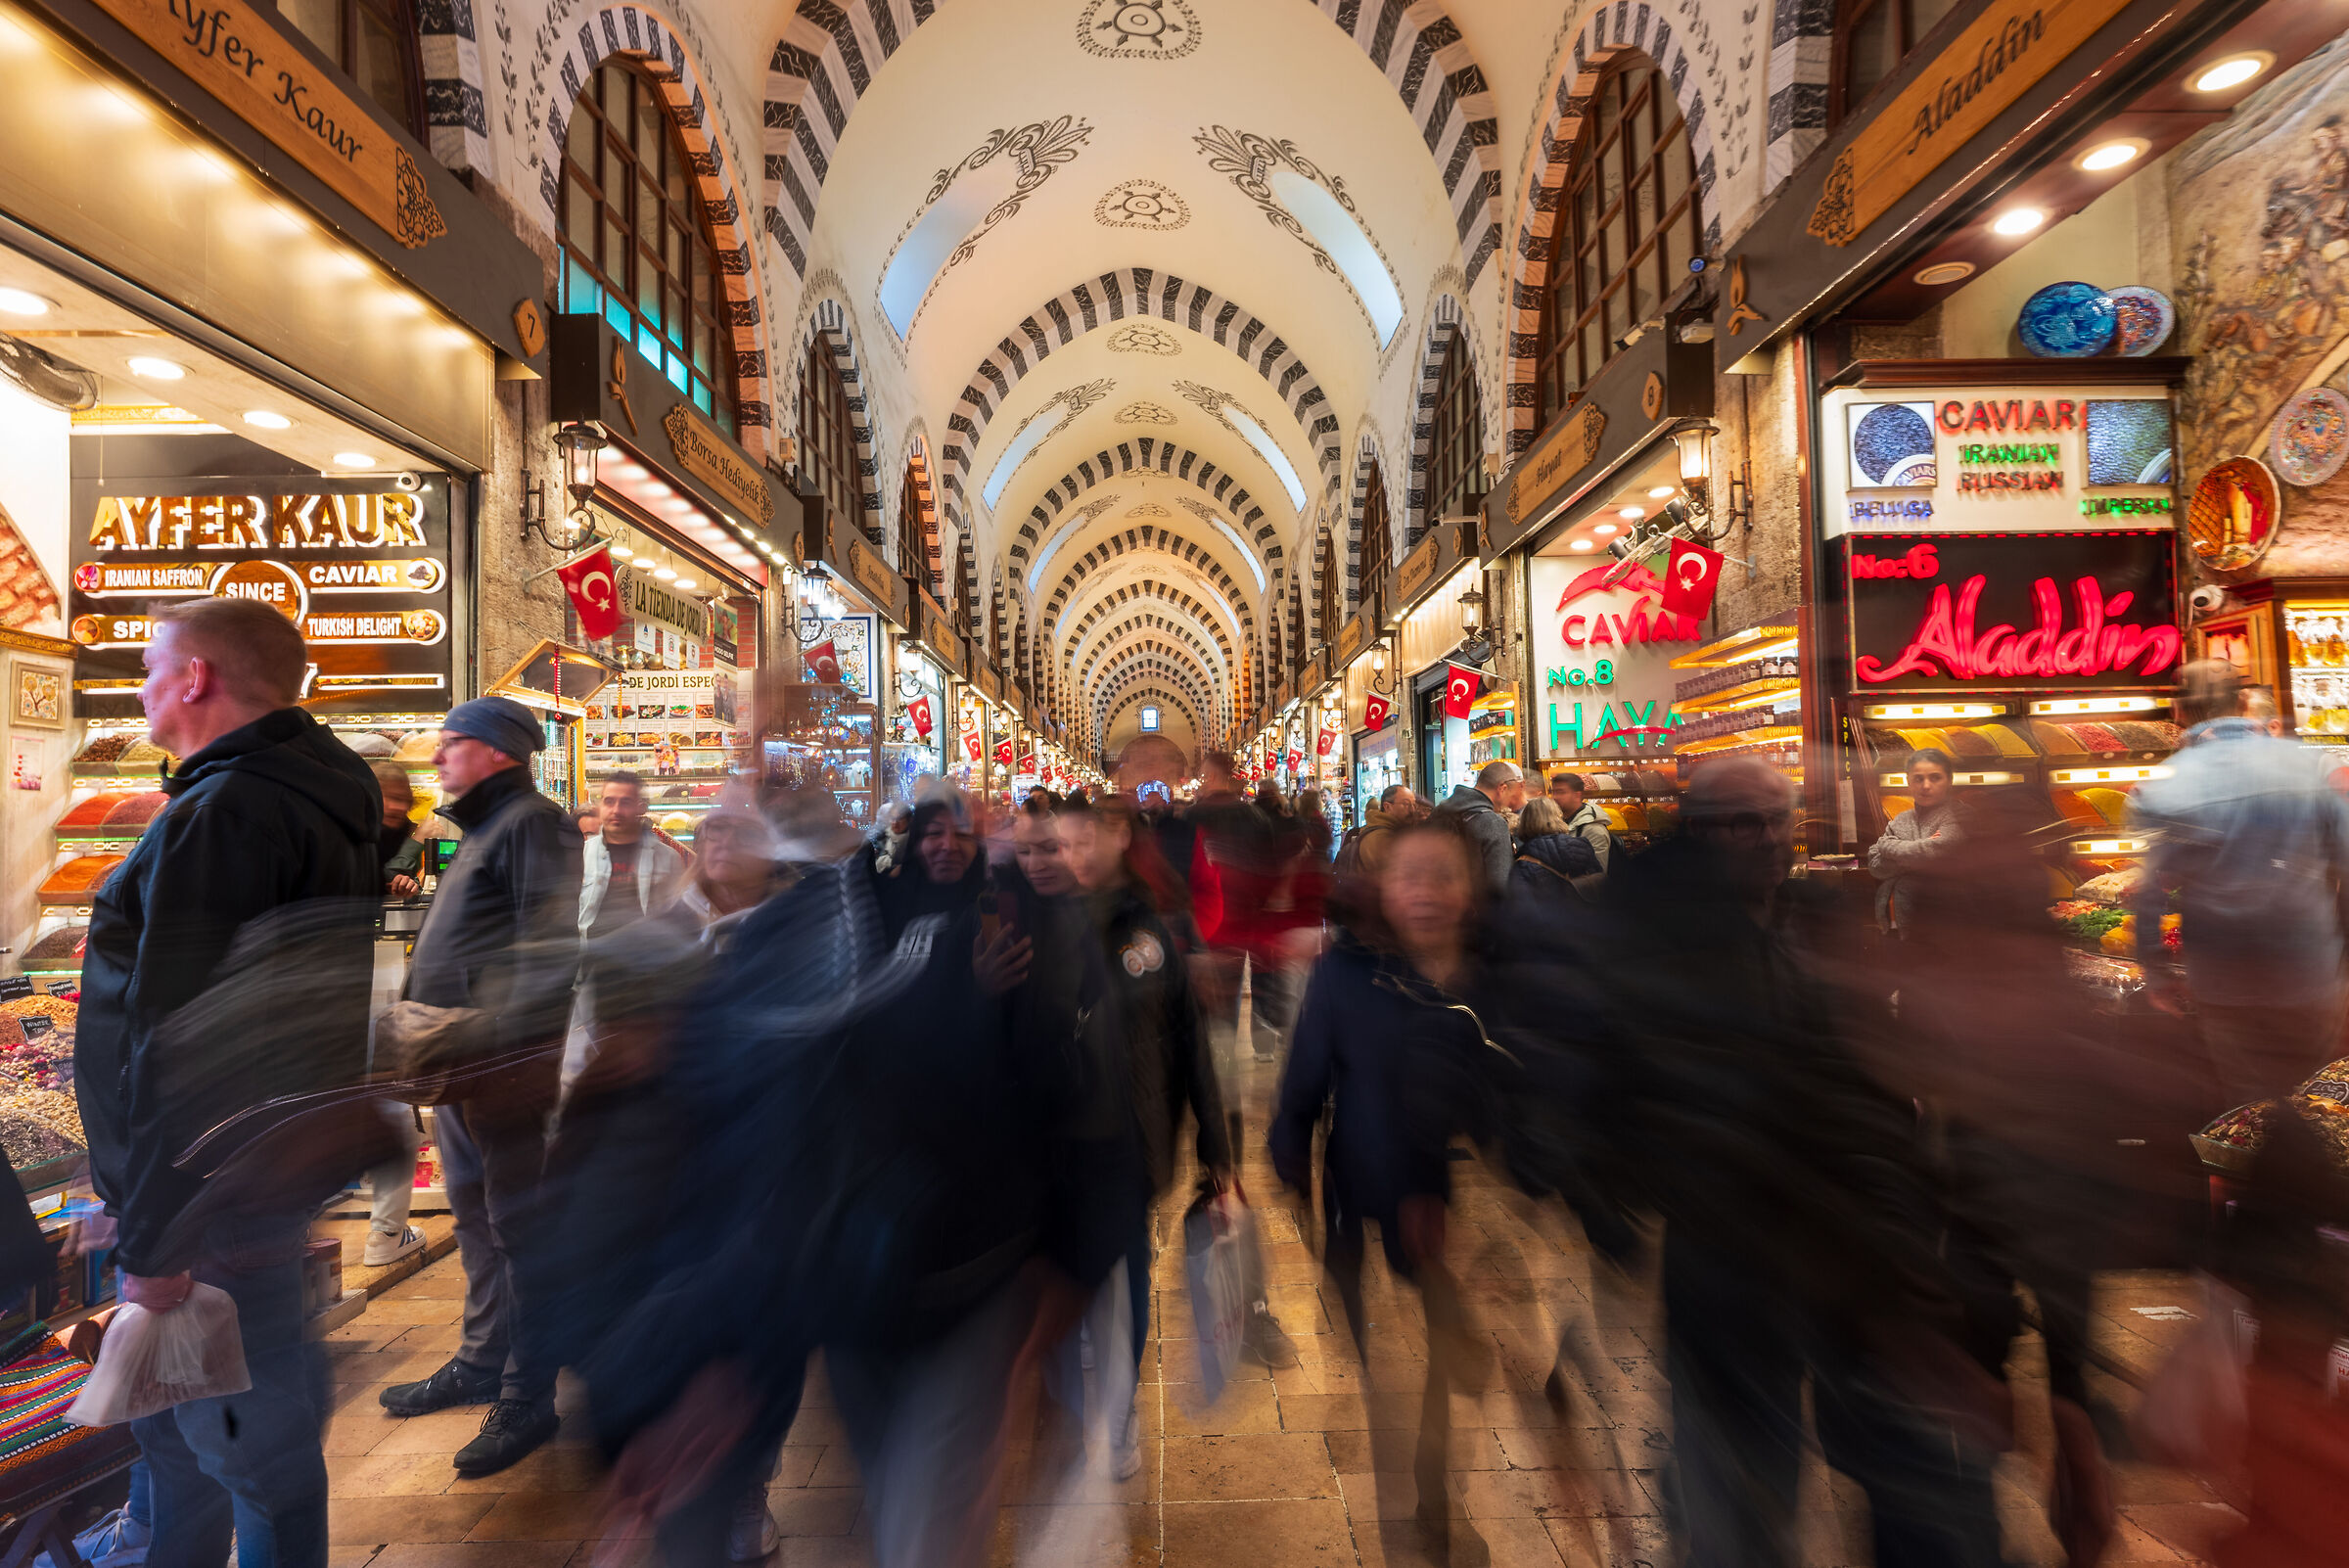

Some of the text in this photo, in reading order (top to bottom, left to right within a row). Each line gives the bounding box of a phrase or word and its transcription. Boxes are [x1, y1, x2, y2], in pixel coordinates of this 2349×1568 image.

[1907, 9, 2043, 156] Aladdin
[273, 71, 363, 162] Kaur
[528, 312, 535, 339] 7
[1940, 399, 2080, 431] CAVIAR
[689, 431, 760, 505] Borsa Hediyelik
[1958, 443, 2060, 464] IRANIAN
[1958, 470, 2064, 492] RUSSIAN
[89, 493, 427, 549] AYFER KAUR
[105, 568, 203, 587] IRANIAN SAFFRON
[225, 581, 285, 601] SINCE
[308, 566, 397, 584] CAVIAR
[635, 580, 646, 613] LA
[676, 599, 685, 628] DE
[113, 622, 165, 639] SPIC
[307, 617, 401, 637] TURKISH DELIGHT
[1561, 611, 1702, 650] CAVIAR
[1856, 575, 2180, 683] Aladdin
[629, 676, 644, 688] DE
[1546, 659, 1614, 691] No.8
[1549, 701, 1685, 750] HAYA
